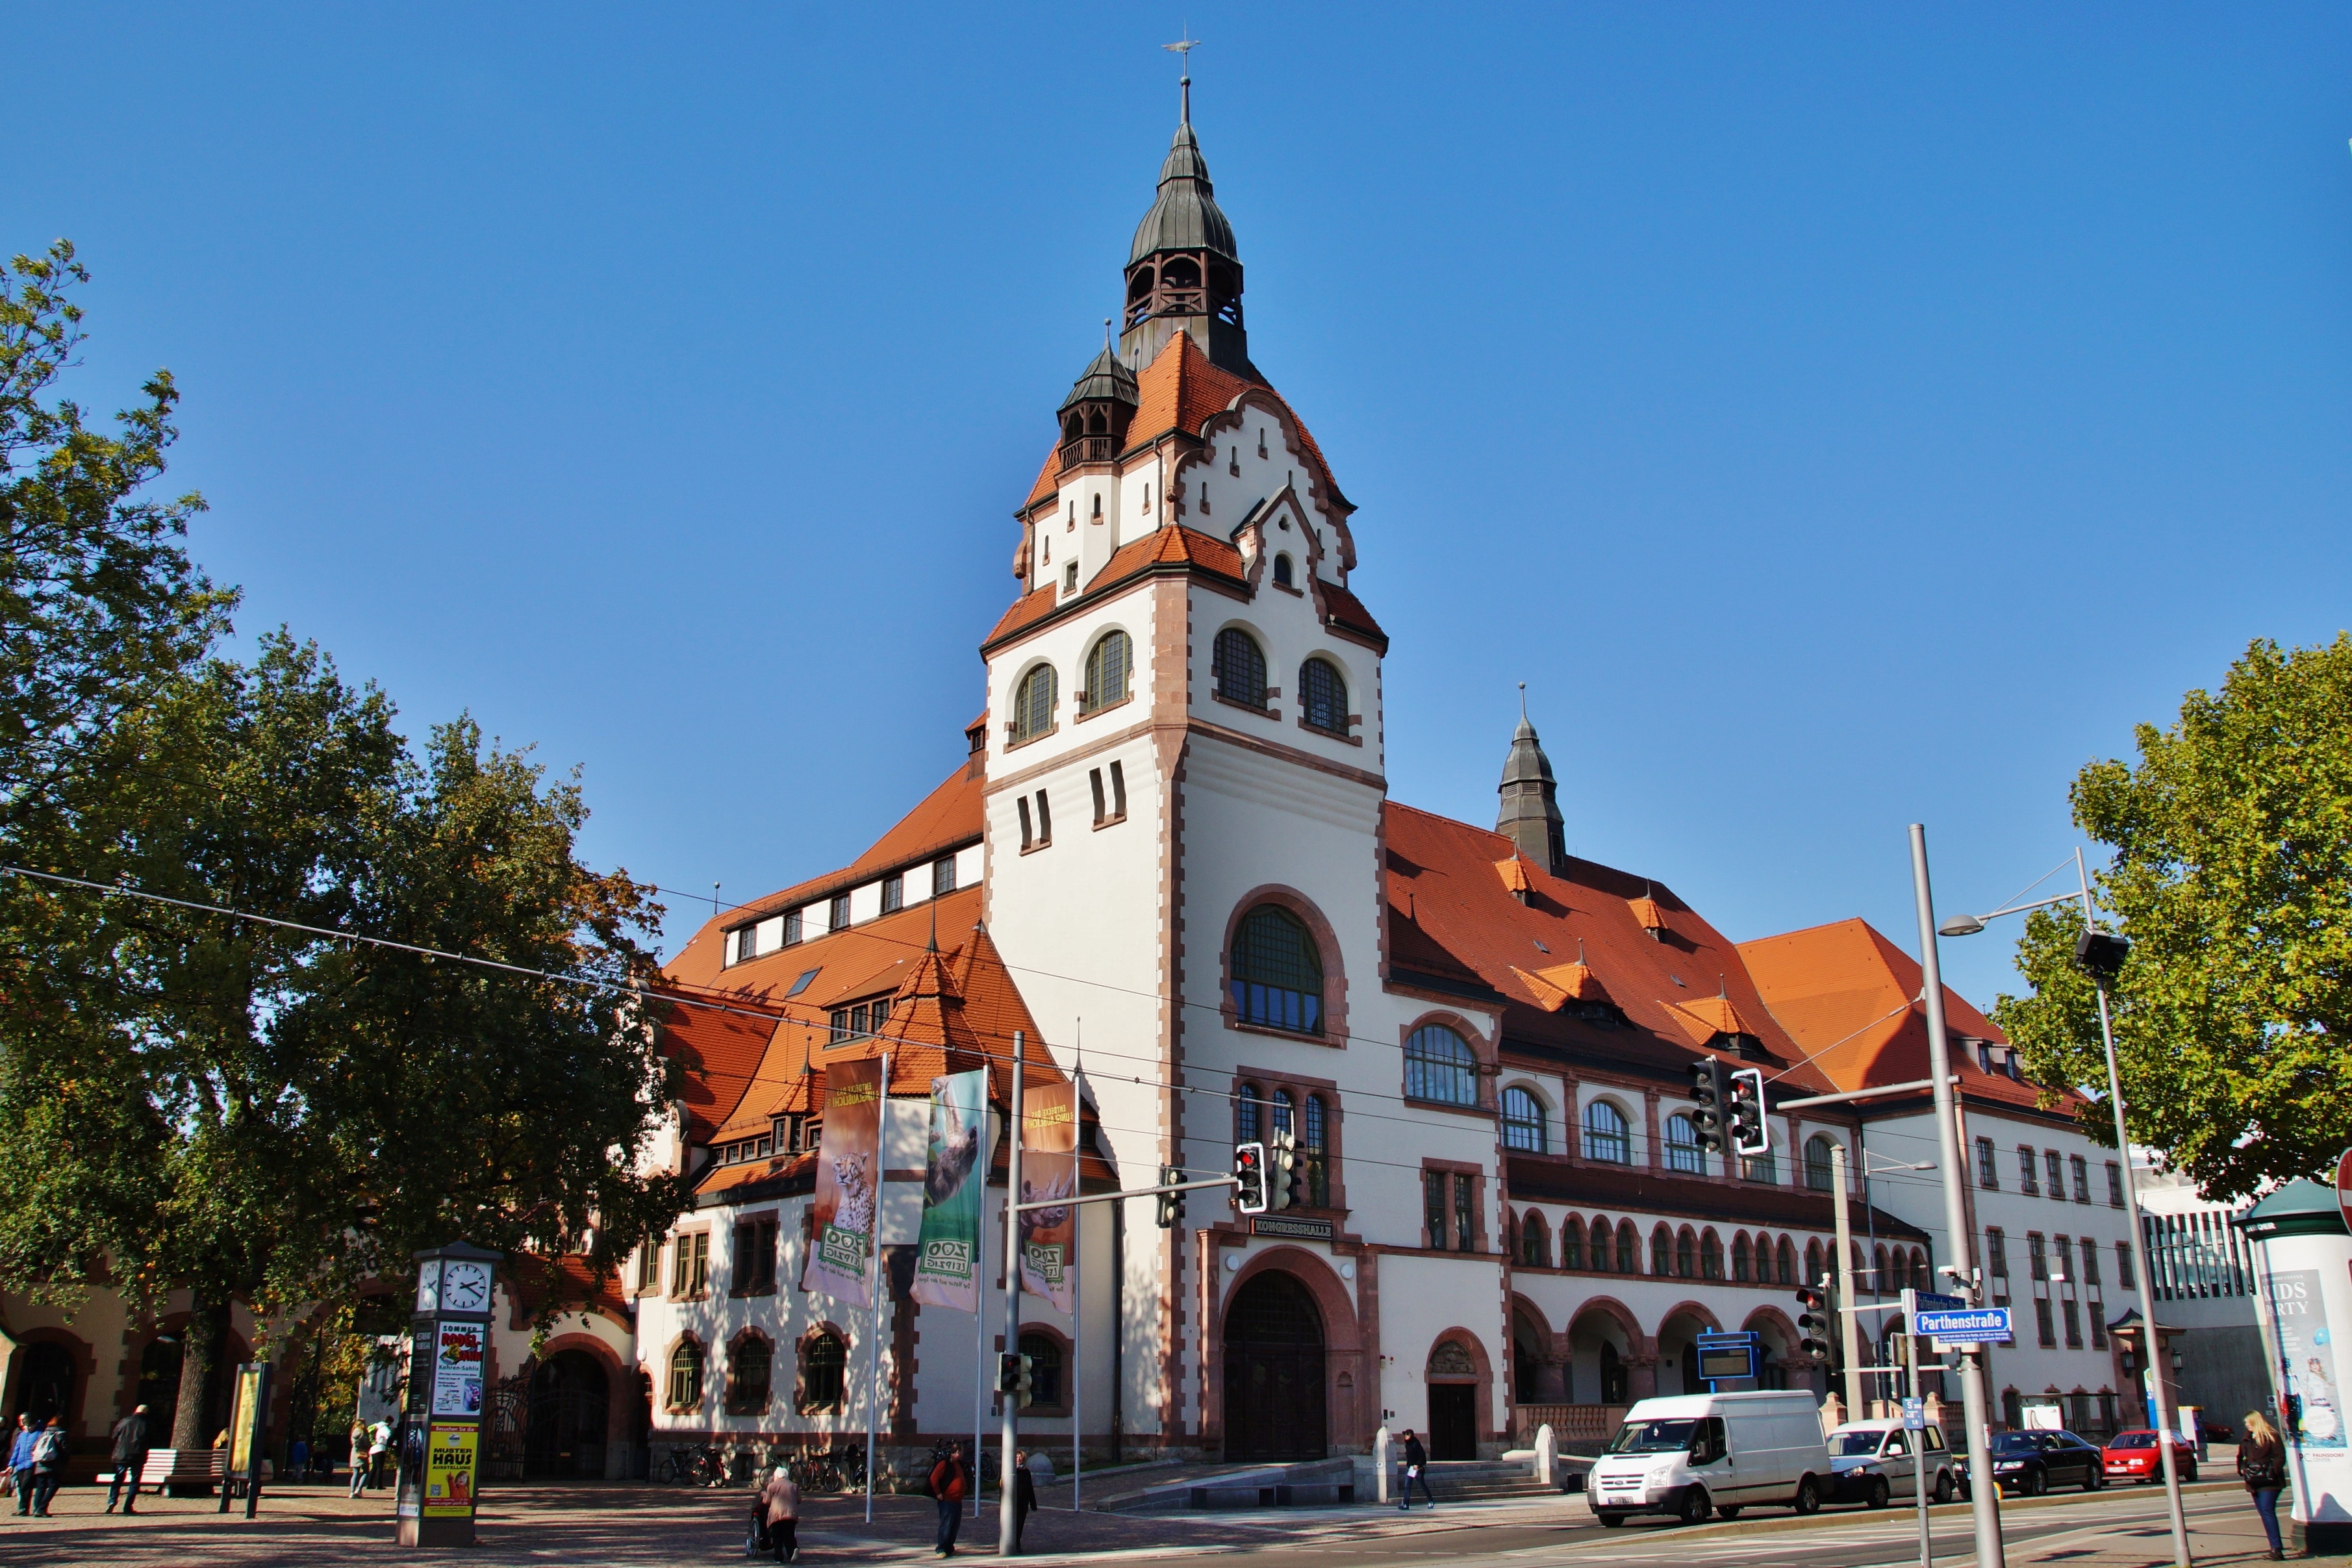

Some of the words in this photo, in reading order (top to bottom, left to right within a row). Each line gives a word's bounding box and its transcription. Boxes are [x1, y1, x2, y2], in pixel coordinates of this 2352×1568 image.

[1256, 1220, 1331, 1237] KONGRESSHALLE
[2262, 1282, 2307, 1302] KIDS
[1916, 1293, 1948, 1309] Pfaffendorfer
[2266, 1301, 2308, 1317] PARTY
[1921, 1312, 2001, 1330] Parthenstraße
[433, 1454, 472, 1465] HAUS
